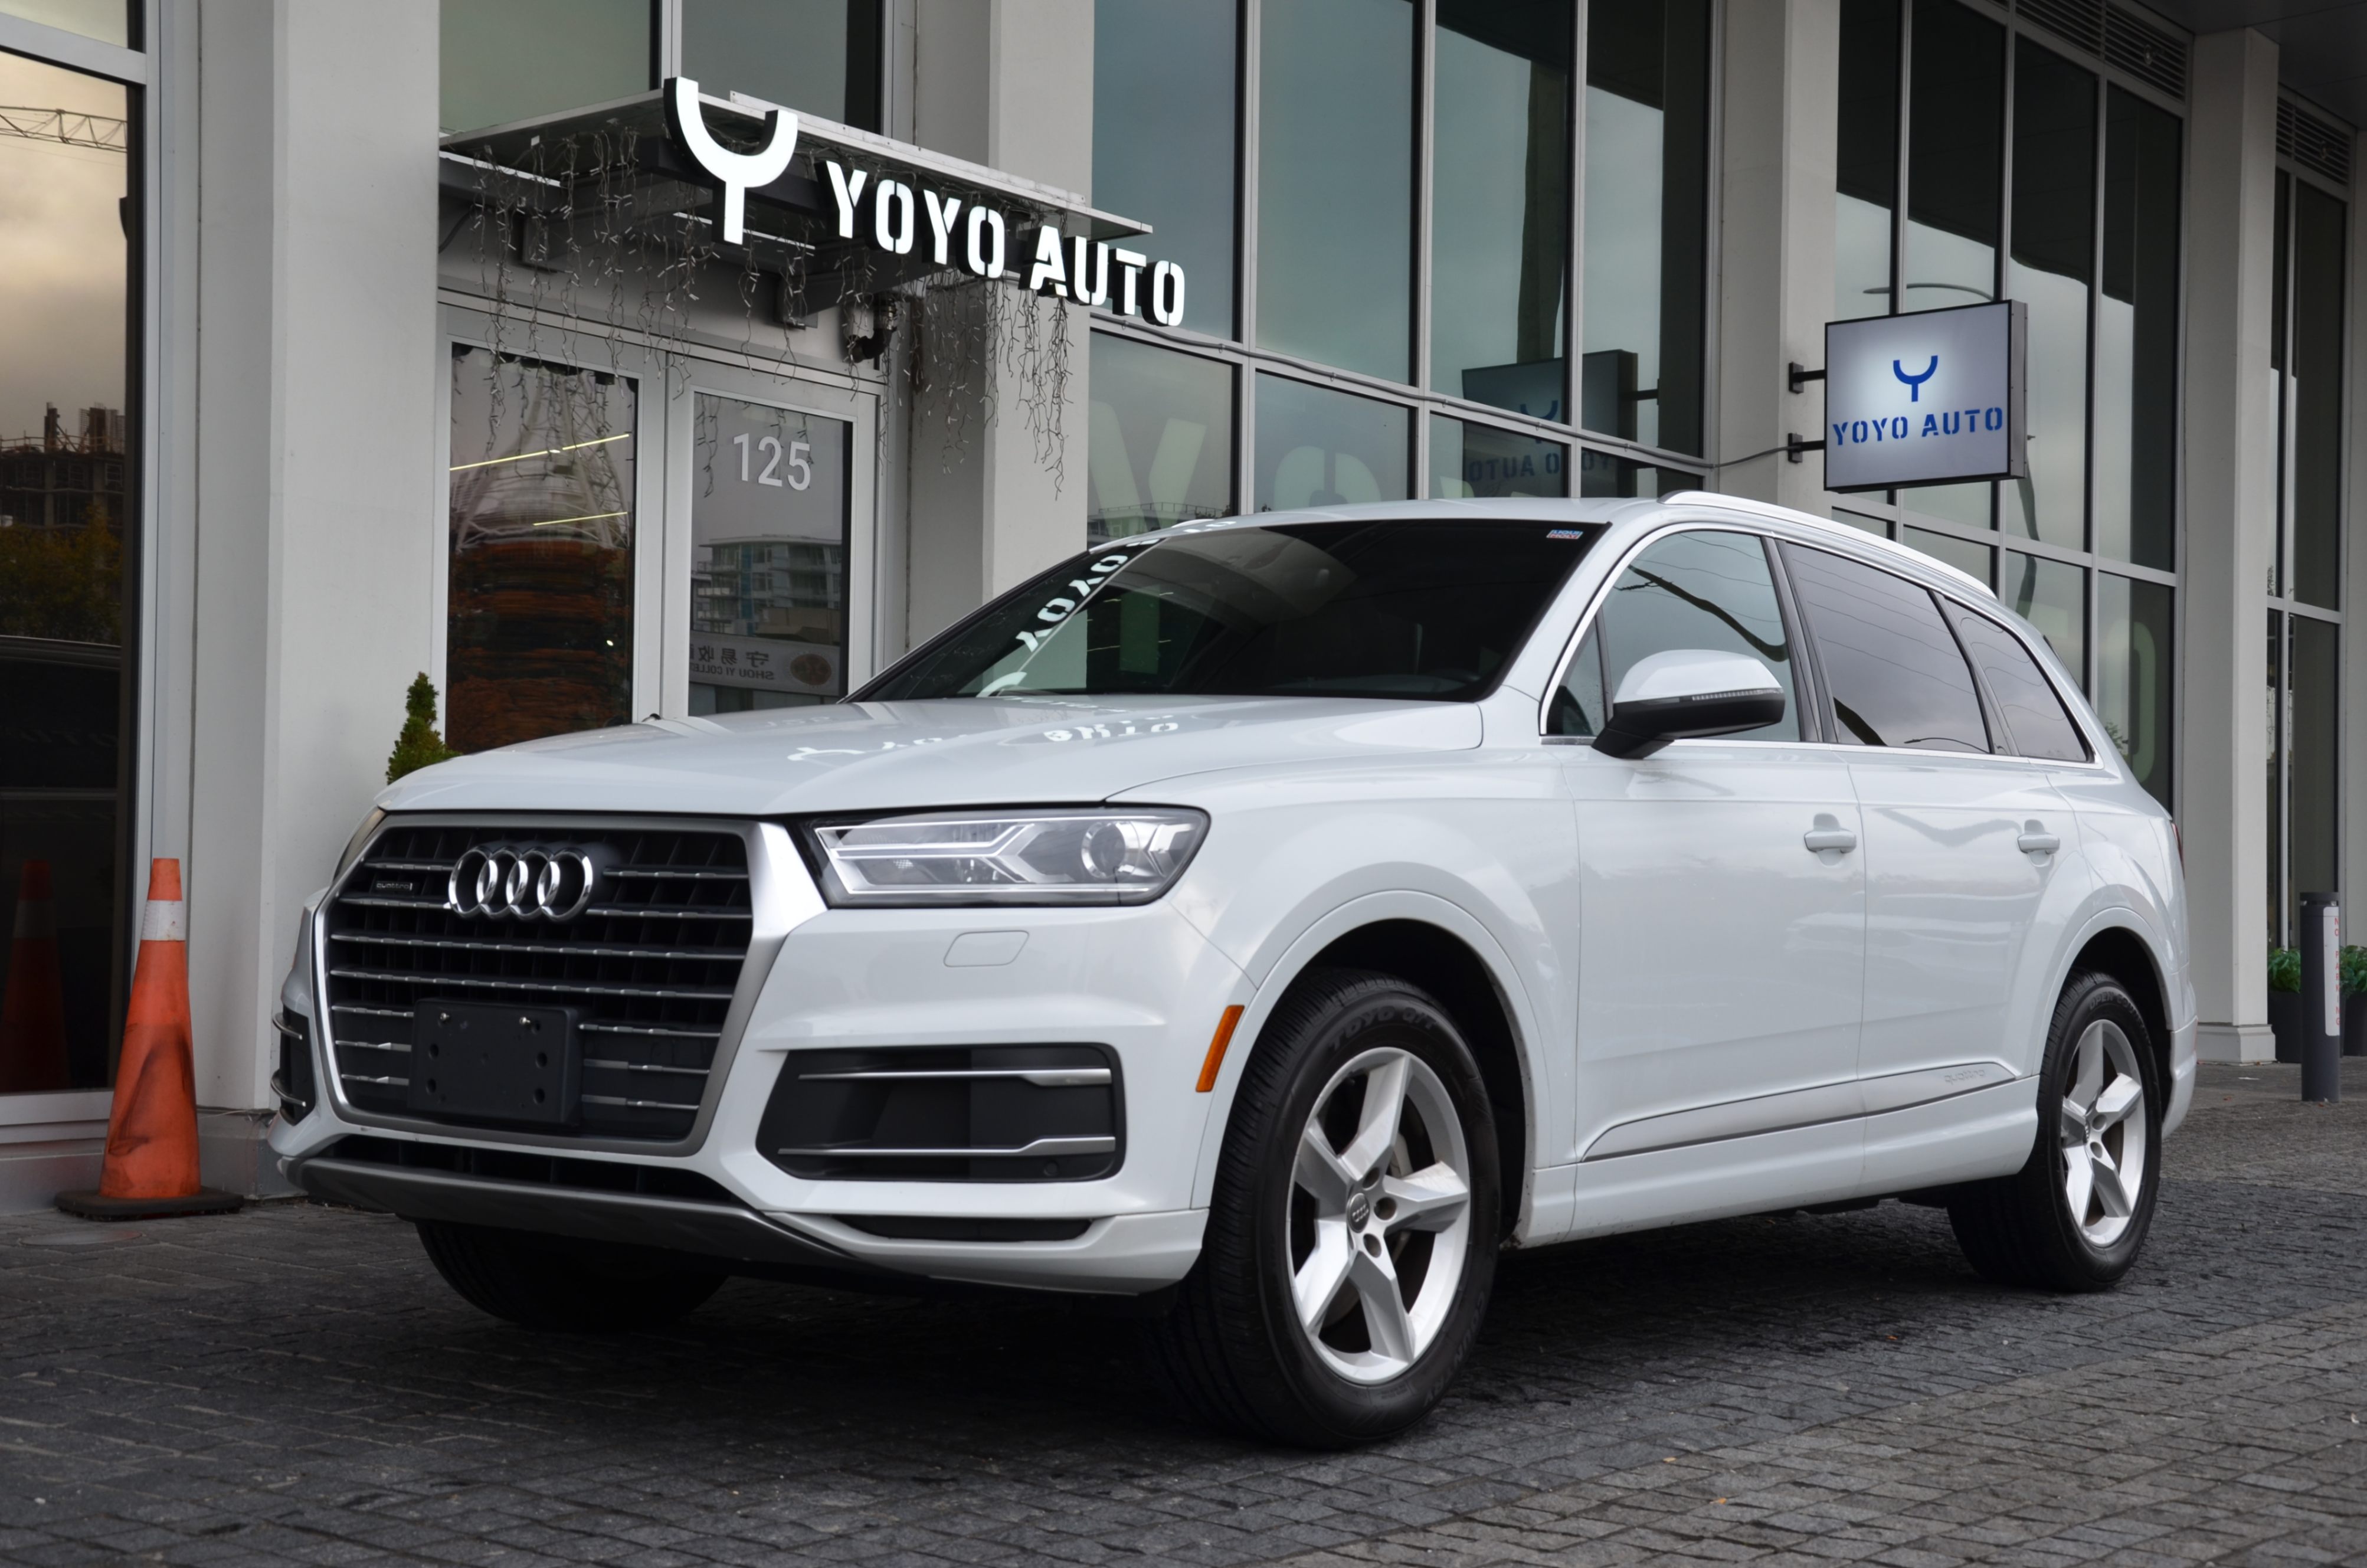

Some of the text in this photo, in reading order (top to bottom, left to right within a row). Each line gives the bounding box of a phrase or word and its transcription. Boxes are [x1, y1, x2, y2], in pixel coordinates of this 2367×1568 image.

[825, 161, 1185, 327] YOYO AUTO
[1832, 407, 2003, 446] YOYO AUTO
[733, 433, 811, 491] 125
[1329, 1005, 1396, 1052] TOYO
[1944, 1069, 1985, 1085] quattro
